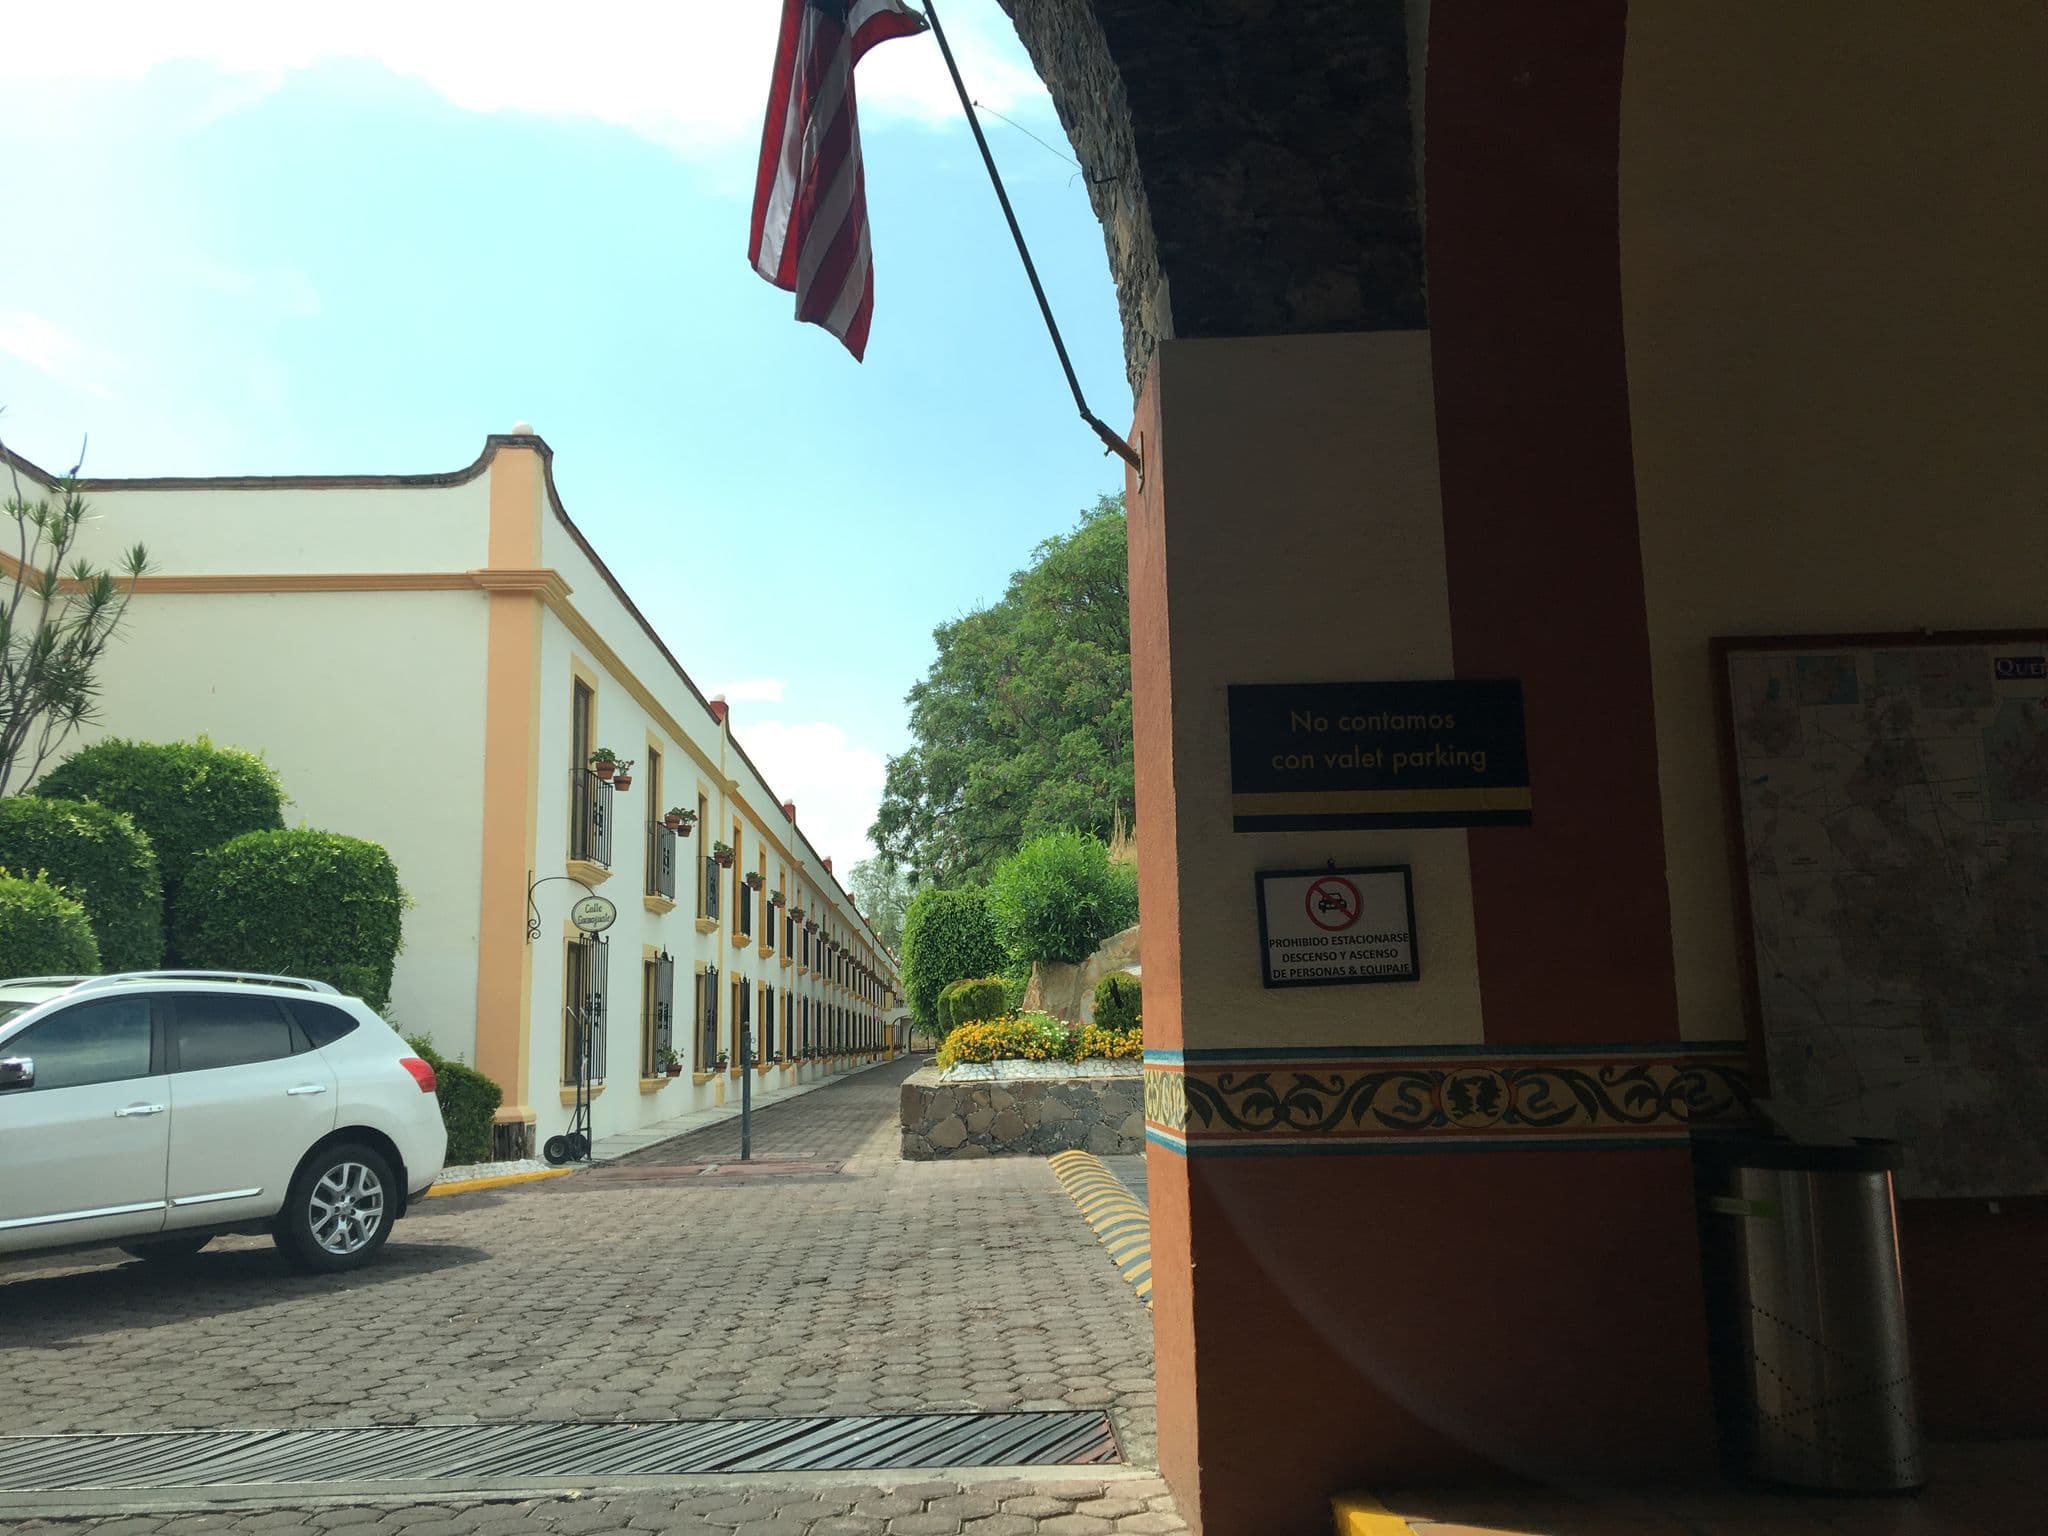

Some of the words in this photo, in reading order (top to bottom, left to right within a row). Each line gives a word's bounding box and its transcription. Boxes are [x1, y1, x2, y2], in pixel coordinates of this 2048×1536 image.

[1290, 710, 1328, 732] No
[1338, 712, 1456, 731] contamos
[1271, 752, 1315, 769] con
[1324, 744, 1385, 768] valet
[1392, 743, 1487, 774] parking
[584, 903, 602, 914] Calle
[1269, 936, 1329, 948] PROHIBIDO
[1331, 932, 1409, 945] ESTACIONARSE
[1282, 951, 1337, 963] DESCENSO
[1341, 951, 1348, 960] Y
[1350, 949, 1399, 960] ASCENSO
[1273, 969, 1287, 980] DE
[1290, 966, 1346, 978] PERSONAS
[1349, 966, 1358, 976] &
[1360, 963, 1410, 975] EQUIPAJE
